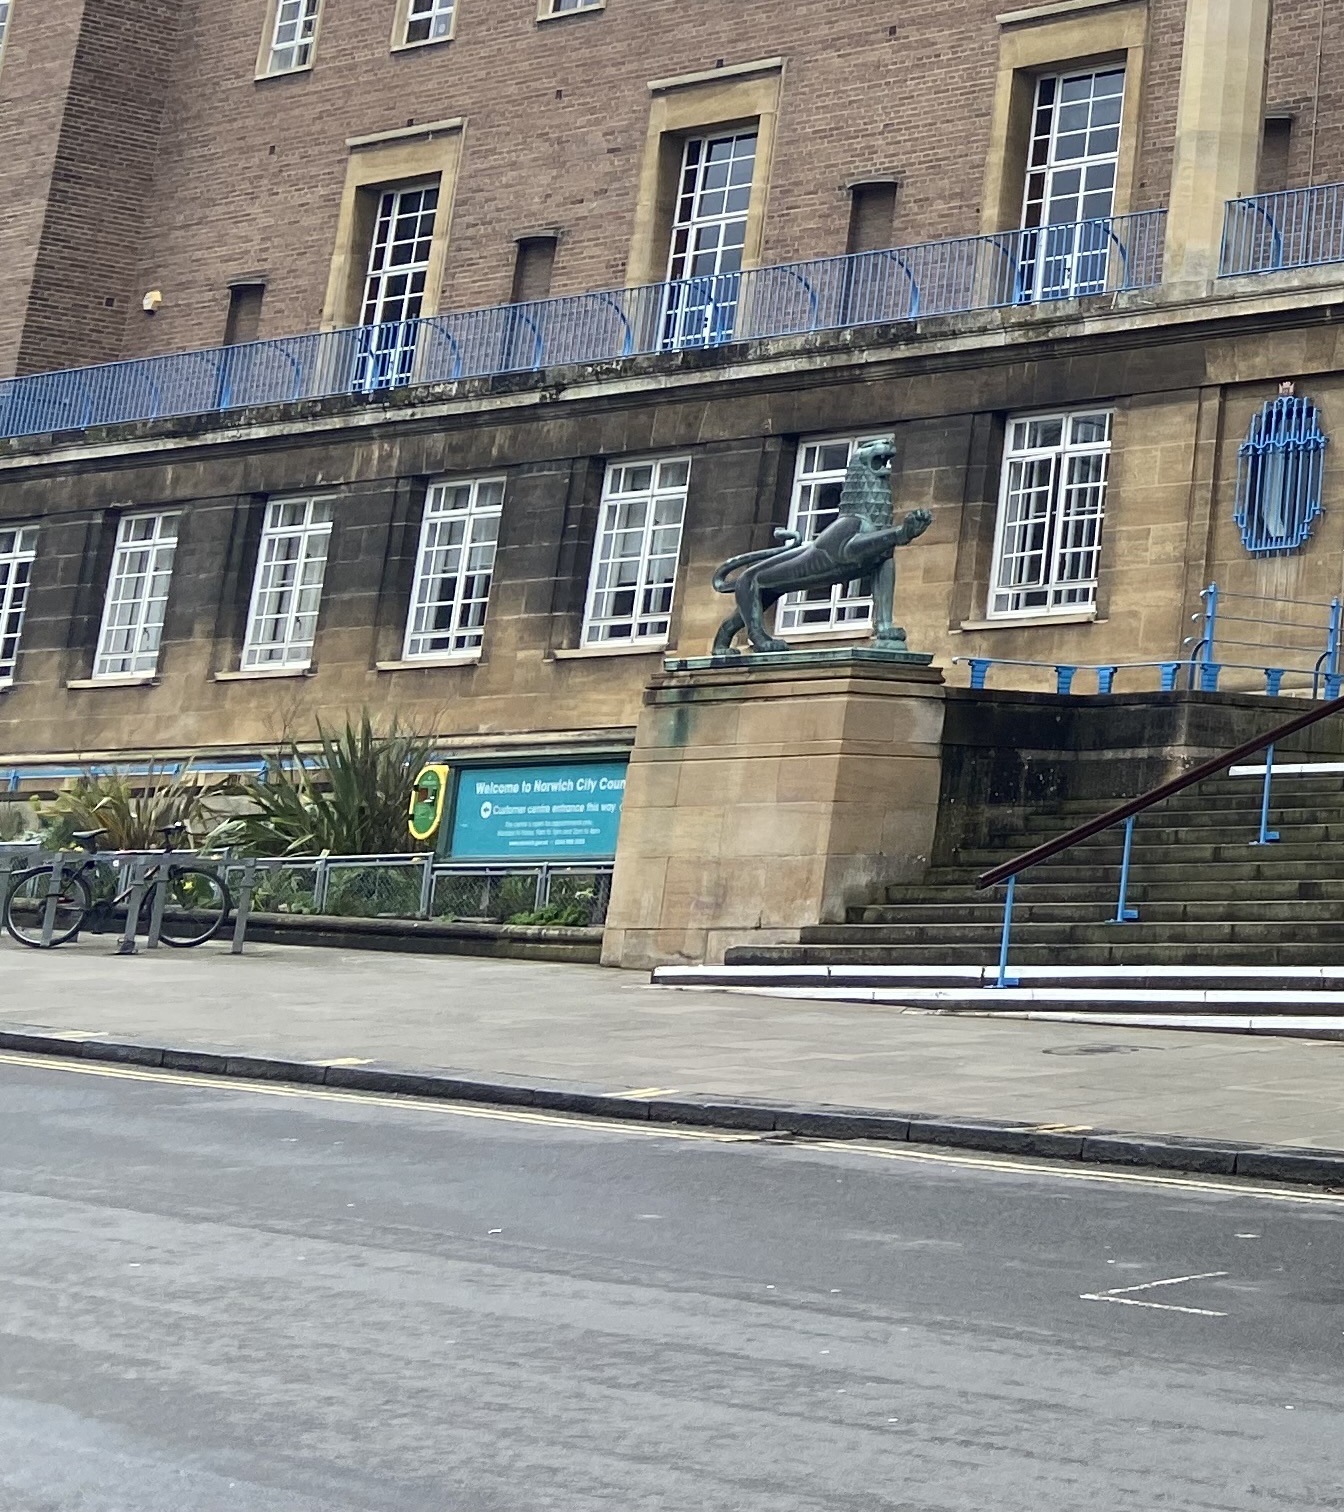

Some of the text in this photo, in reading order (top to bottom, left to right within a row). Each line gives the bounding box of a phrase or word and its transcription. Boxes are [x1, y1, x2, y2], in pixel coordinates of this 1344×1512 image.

[475, 781, 519, 795] Welcome
[521, 780, 531, 793] to
[533, 779, 574, 793] Norwich
[576, 778, 597, 793] City
[493, 805, 526, 815] Customer
[527, 804, 550, 814] centre
[586, 802, 600, 812] this
[600, 803, 617, 813] way
